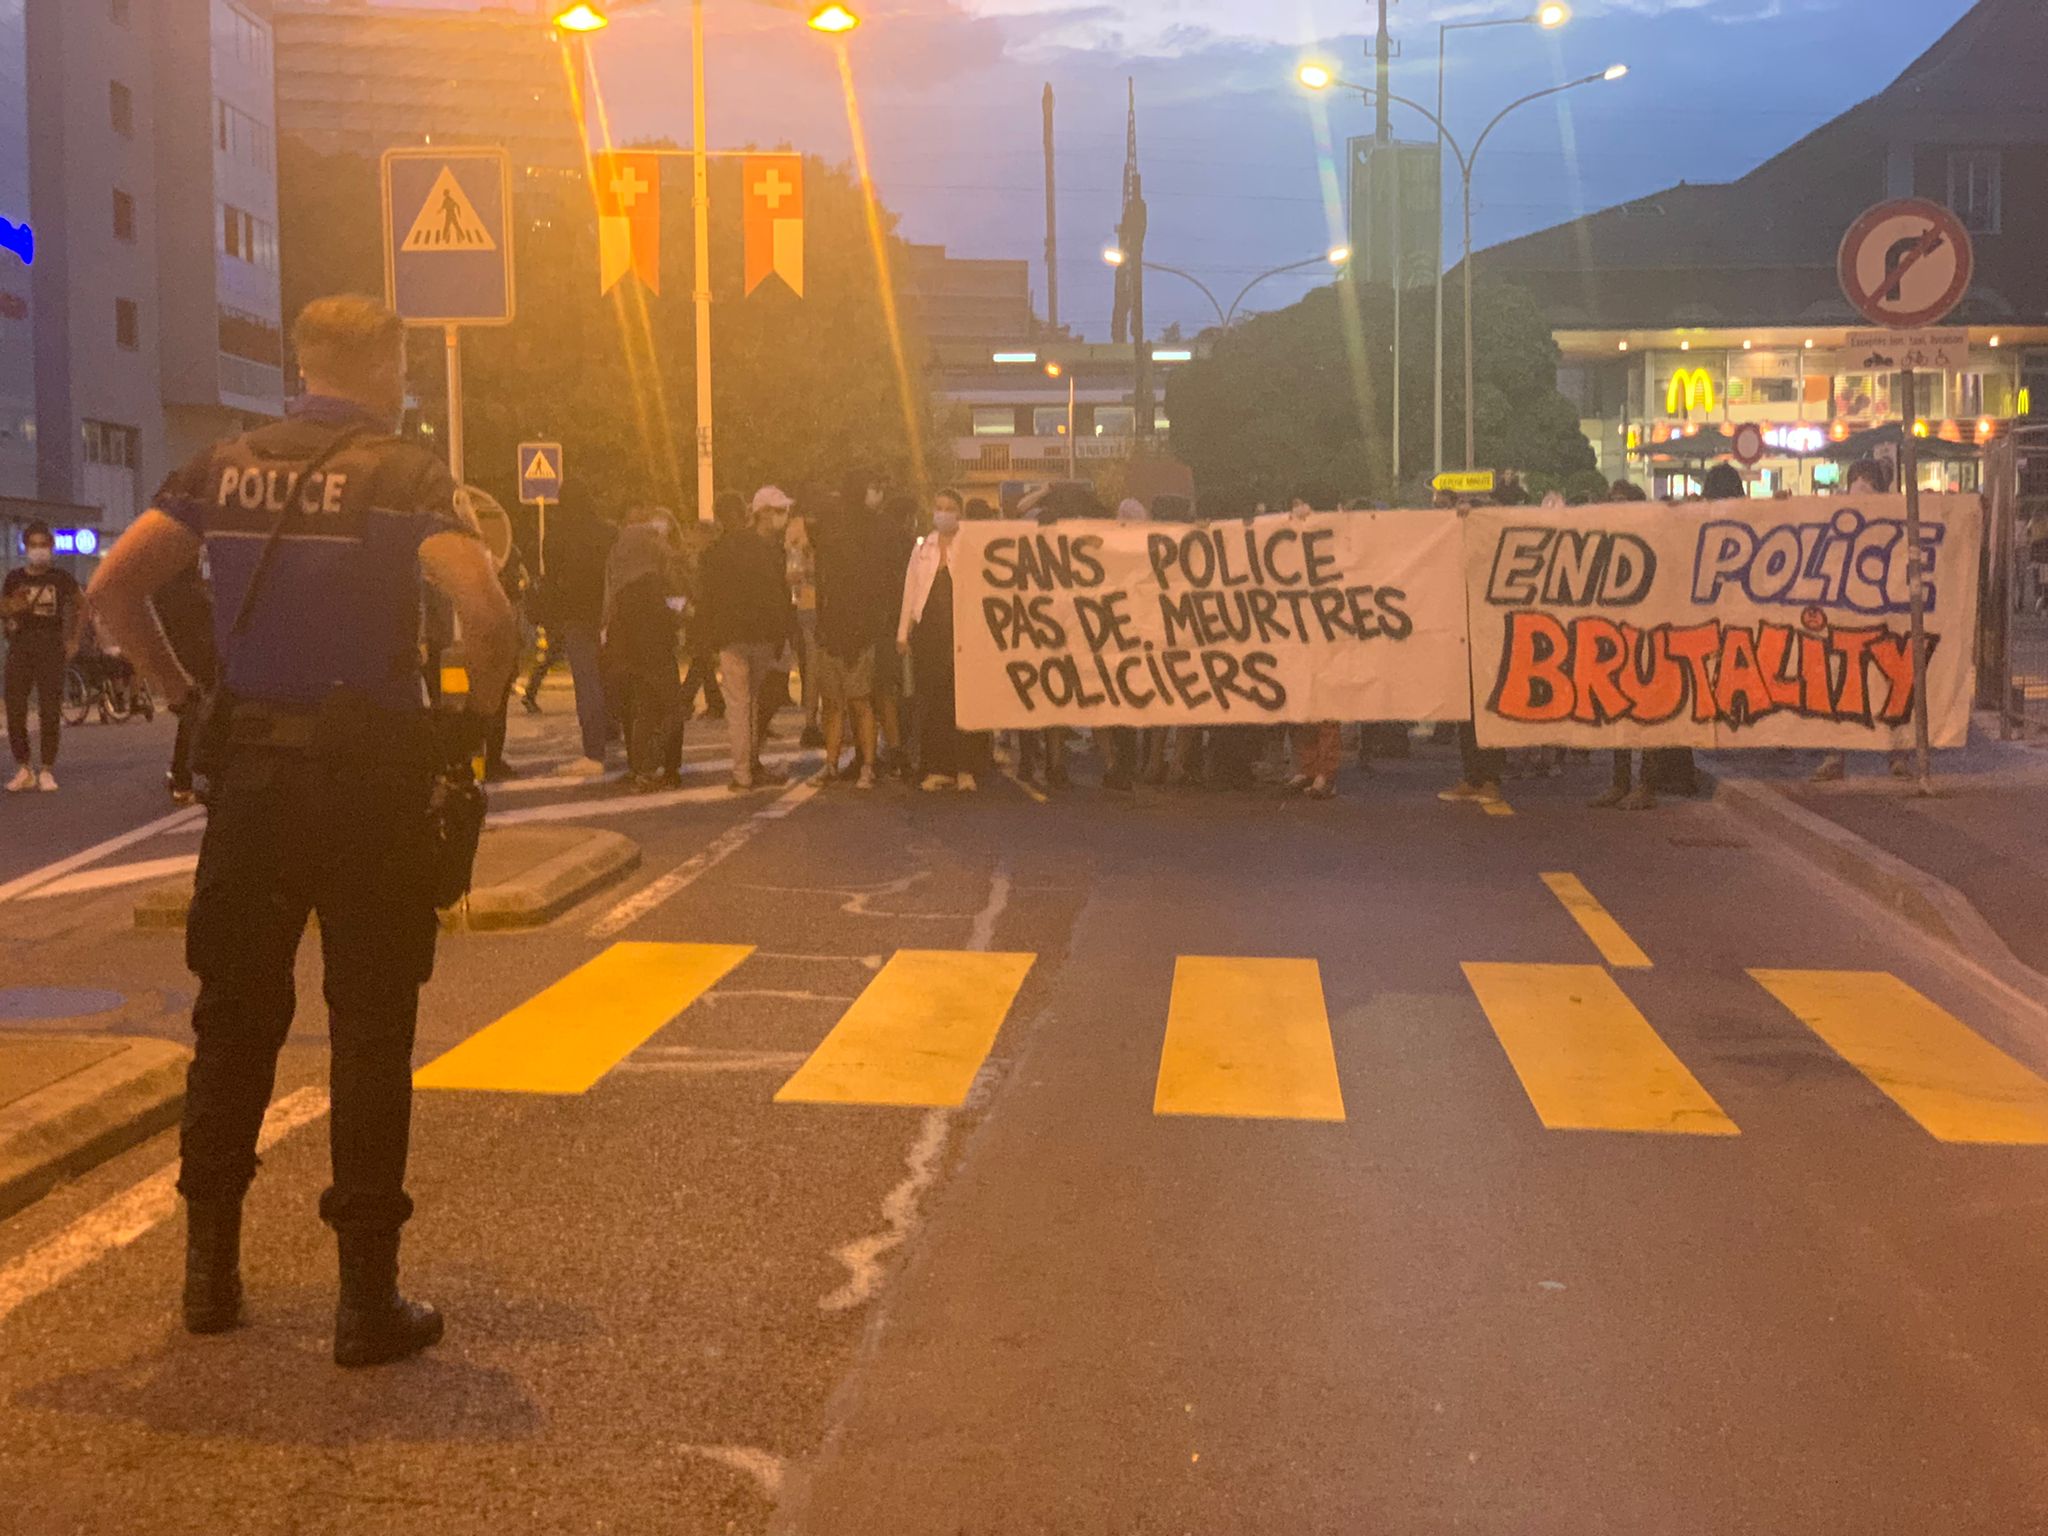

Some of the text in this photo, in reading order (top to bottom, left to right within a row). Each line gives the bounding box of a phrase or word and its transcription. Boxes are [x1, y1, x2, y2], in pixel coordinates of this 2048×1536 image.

[217, 466, 348, 514] POLICE
[981, 528, 1345, 592] SANS POLICE
[1484, 525, 1658, 607] END
[981, 585, 1414, 653] PAS DE MEURTRES
